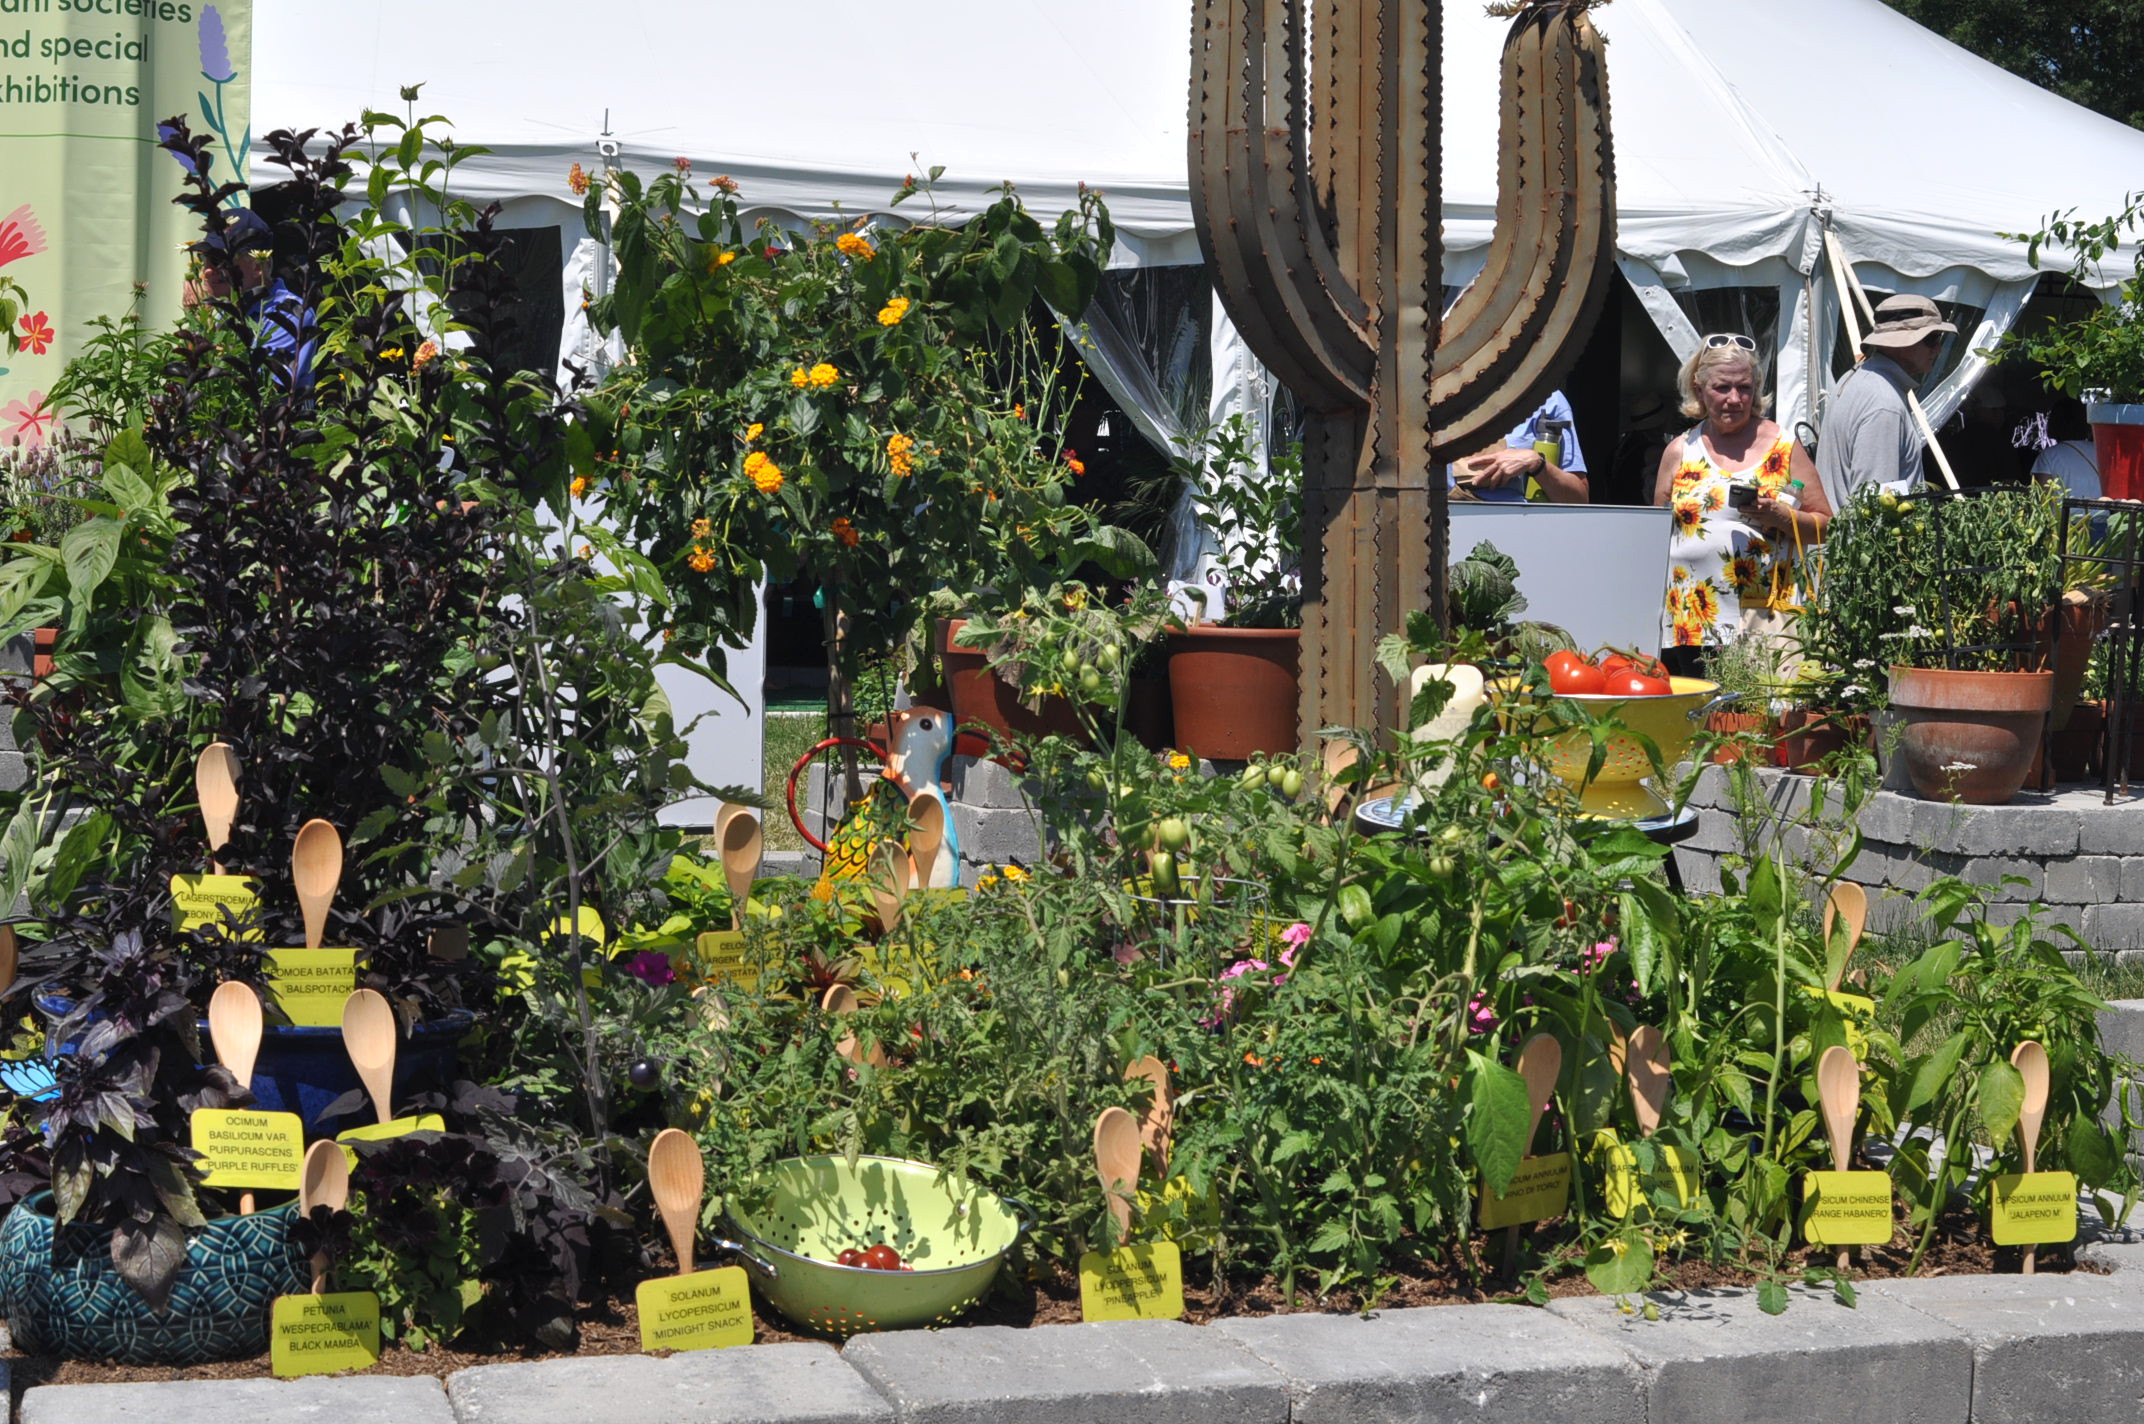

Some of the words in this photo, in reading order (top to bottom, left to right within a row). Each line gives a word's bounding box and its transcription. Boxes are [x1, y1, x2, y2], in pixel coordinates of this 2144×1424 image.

[41, 33, 148, 65] special
[0, 75, 140, 105] hibitions
[316, 967, 355, 976] BATATA
[225, 1116, 268, 1127] OCIMUM
[208, 1130, 264, 1141] BASILICUM
[266, 1132, 289, 1142] VAR.
[208, 1145, 293, 1157] PURPURASCENS
[205, 1160, 248, 1171] 'PURPLE
[250, 1162, 299, 1172] RUFFLES'
[1820, 1195, 1848, 1205] SICUM
[1849, 1195, 1890, 1204] CHINENSE
[1995, 1194, 2037, 1205] CAPSICUM
[2038, 1193, 2071, 1203] ANNUUM
[1105, 1260, 1153, 1275] SOLANUM
[1094, 1273, 1168, 1292] LYCOPERSICUM
[670, 1286, 721, 1303] SOLANUM
[303, 1304, 345, 1316] PETUNIA
[659, 1299, 740, 1322] LYCOPERSICUM
[289, 1340, 321, 1352] BLACK
[323, 1338, 360, 1350] MAMBA
